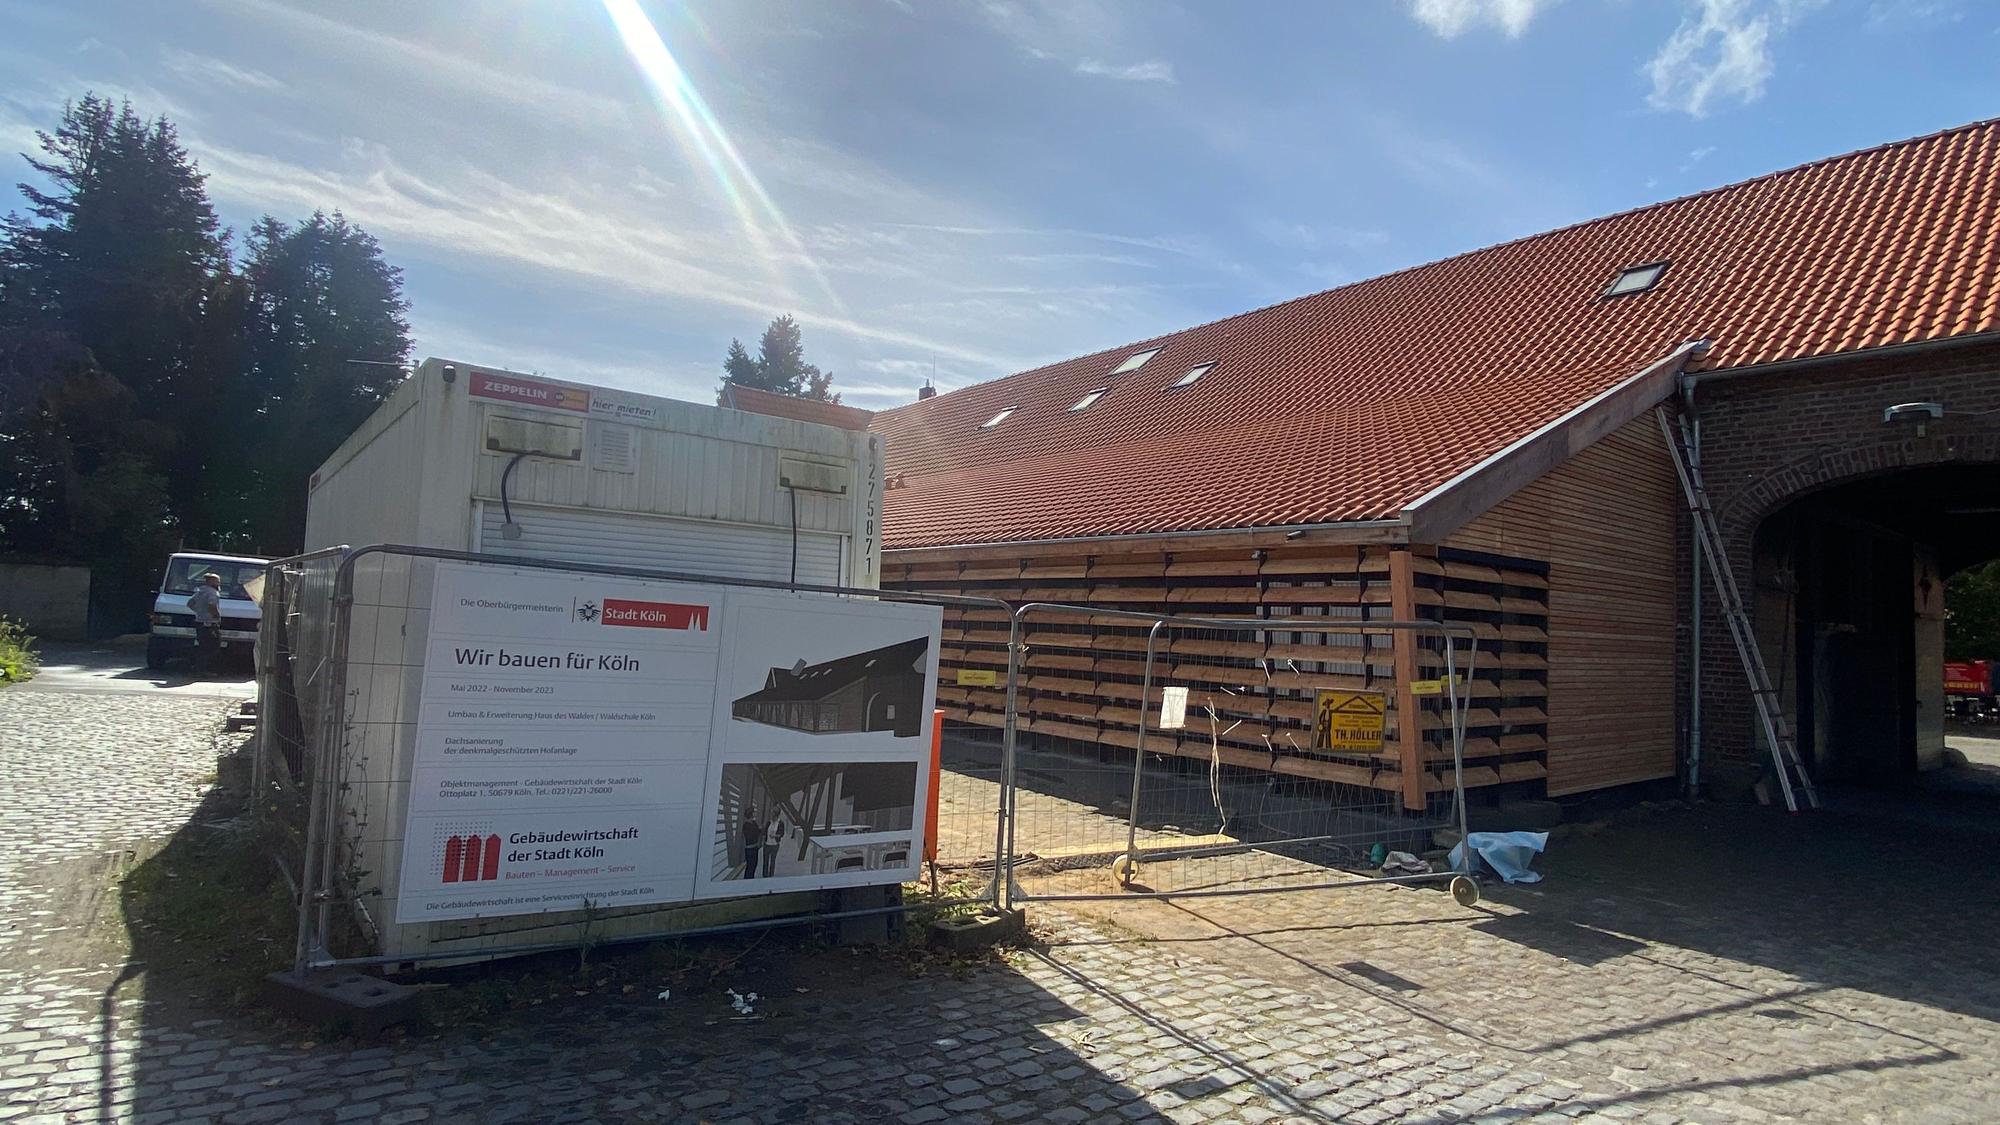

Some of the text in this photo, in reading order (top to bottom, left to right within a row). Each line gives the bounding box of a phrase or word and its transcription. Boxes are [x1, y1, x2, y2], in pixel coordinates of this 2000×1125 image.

[483, 381, 548, 399] ZEPPELIN
[592, 398, 613, 410] hier
[460, 598, 564, 613] Die Oberbürgermeisterin
[605, 607, 666, 623] Stadt Köln
[455, 648, 640, 672] Wir bauen für Köln
[451, 684, 465, 692] Mai
[466, 684, 487, 692] 2022
[494, 686, 533, 694] November
[487, 712, 533, 720] Erweiterung
[445, 737, 503, 746] Dachsanierung
[1335, 728, 1382, 741] TH. HÖLLER
[459, 747, 539, 756] denkmalgeschützten
[540, 748, 577, 756] Hofanlage
[440, 780, 518, 788] Objektmanagement
[525, 779, 593, 787] Gebäudewirtschaft
[440, 789, 477, 798] Ottoplatz
[510, 827, 638, 844] Gebäudewirtschaft
[508, 846, 604, 862] der Stadt Köln
[505, 872, 535, 880] Bauten
[545, 867, 599, 878] Management
[608, 864, 635, 873] Service
[441, 898, 513, 908] Gebäudewirtschaft
[608, 889, 620, 898] der
